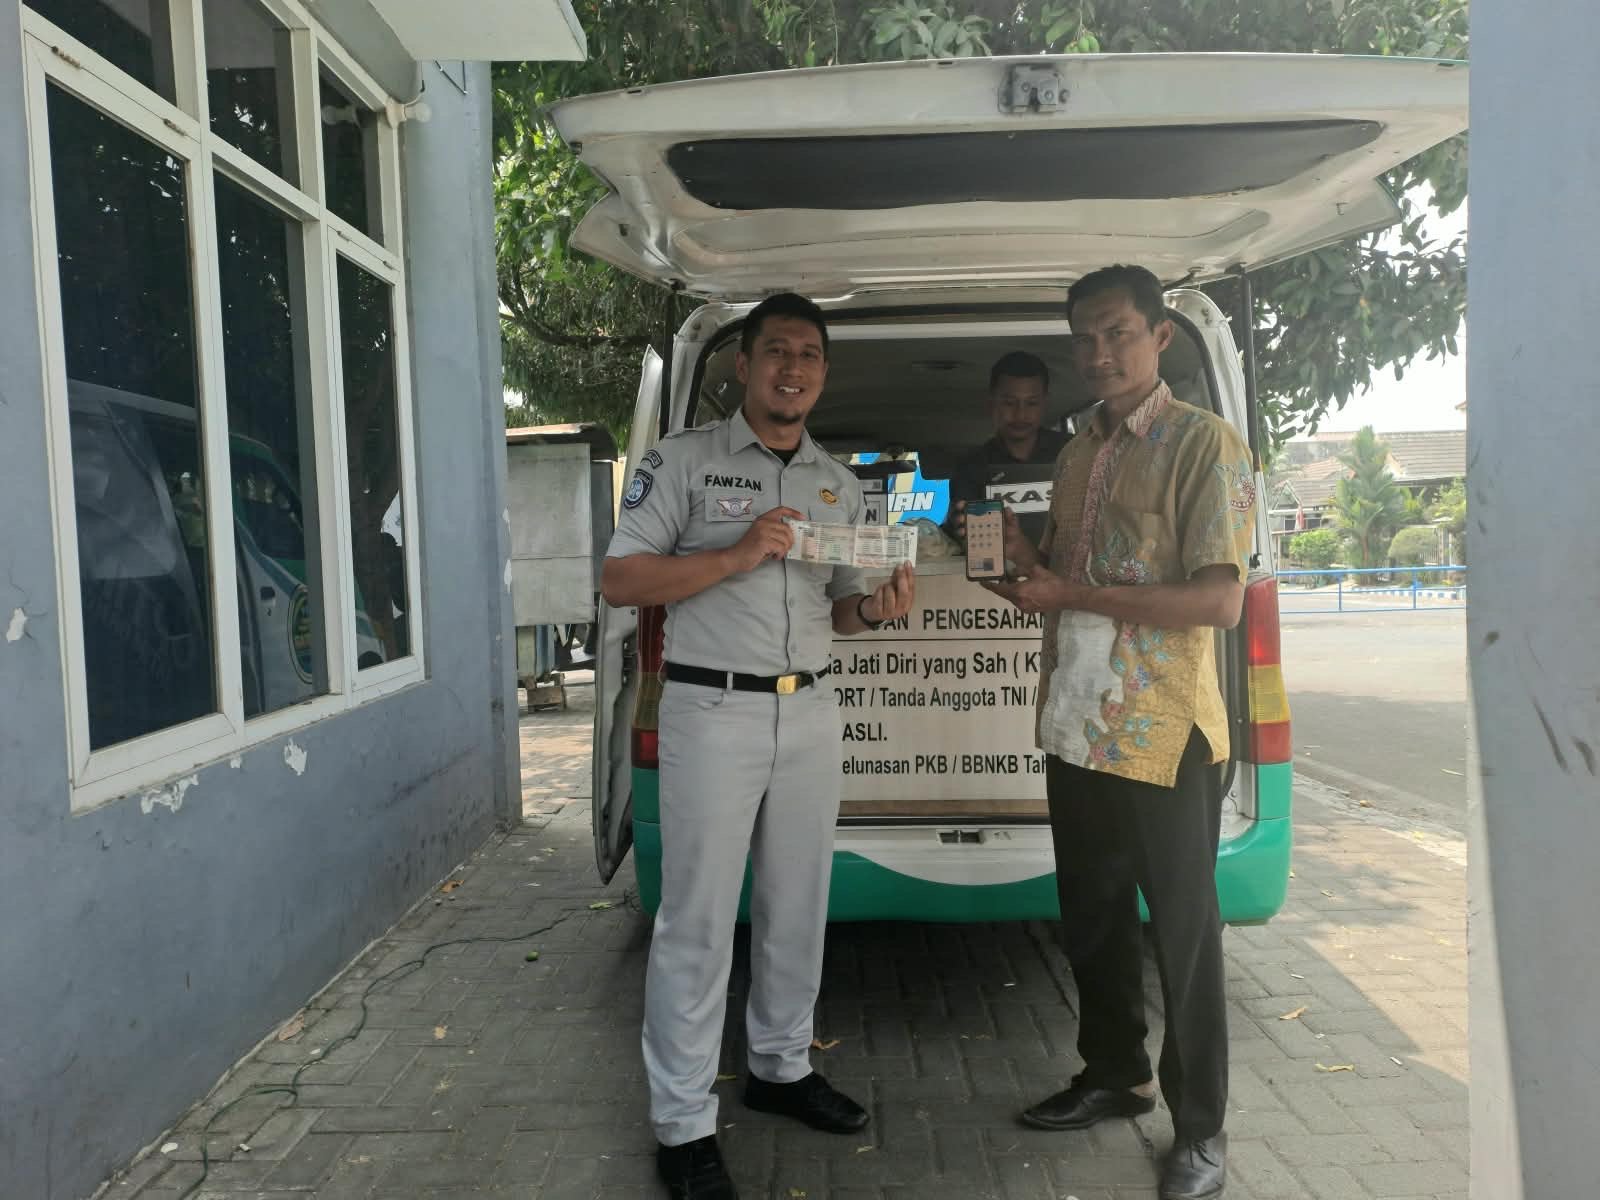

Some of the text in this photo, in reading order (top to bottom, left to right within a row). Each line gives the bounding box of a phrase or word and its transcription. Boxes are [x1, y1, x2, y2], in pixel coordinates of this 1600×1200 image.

[704, 474, 762, 492] FAWZAN
[923, 608, 1044, 630] PENGESAHA
[848, 653, 880, 675] Jati
[886, 653, 917, 675] Diri
[923, 656, 967, 679] yang
[973, 652, 1007, 674] Sah
[879, 687, 926, 707] Tanda
[930, 687, 996, 711] Anggota
[1001, 686, 1027, 707] TNI
[842, 723, 888, 742] ASLI.
[915, 755, 948, 774] PKB
[962, 755, 1018, 774] BBNKB
